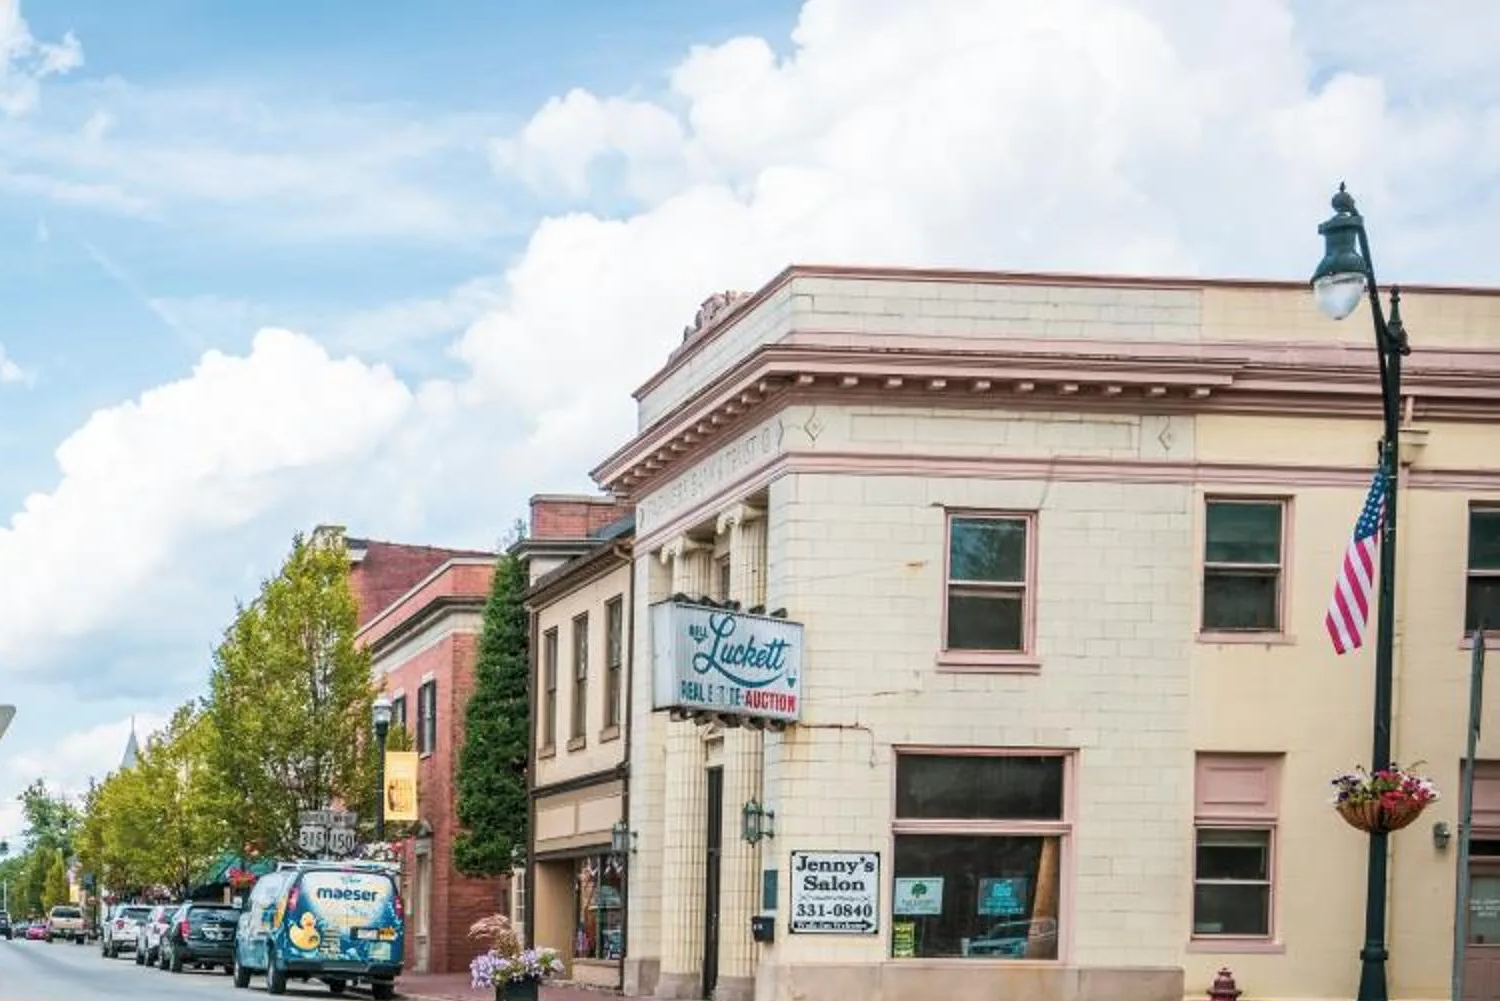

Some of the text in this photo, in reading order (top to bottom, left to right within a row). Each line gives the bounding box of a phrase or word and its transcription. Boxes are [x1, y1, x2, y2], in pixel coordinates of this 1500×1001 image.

[692, 612, 792, 688] Luckett
[681, 681, 704, 702] REAL
[745, 690, 796, 713] AUCTION
[332, 832, 354, 849] 150
[796, 856, 874, 875] Jenny's
[803, 876, 865, 891] Salon
[317, 886, 378, 901] maeser
[796, 903, 873, 918] 331-0840
